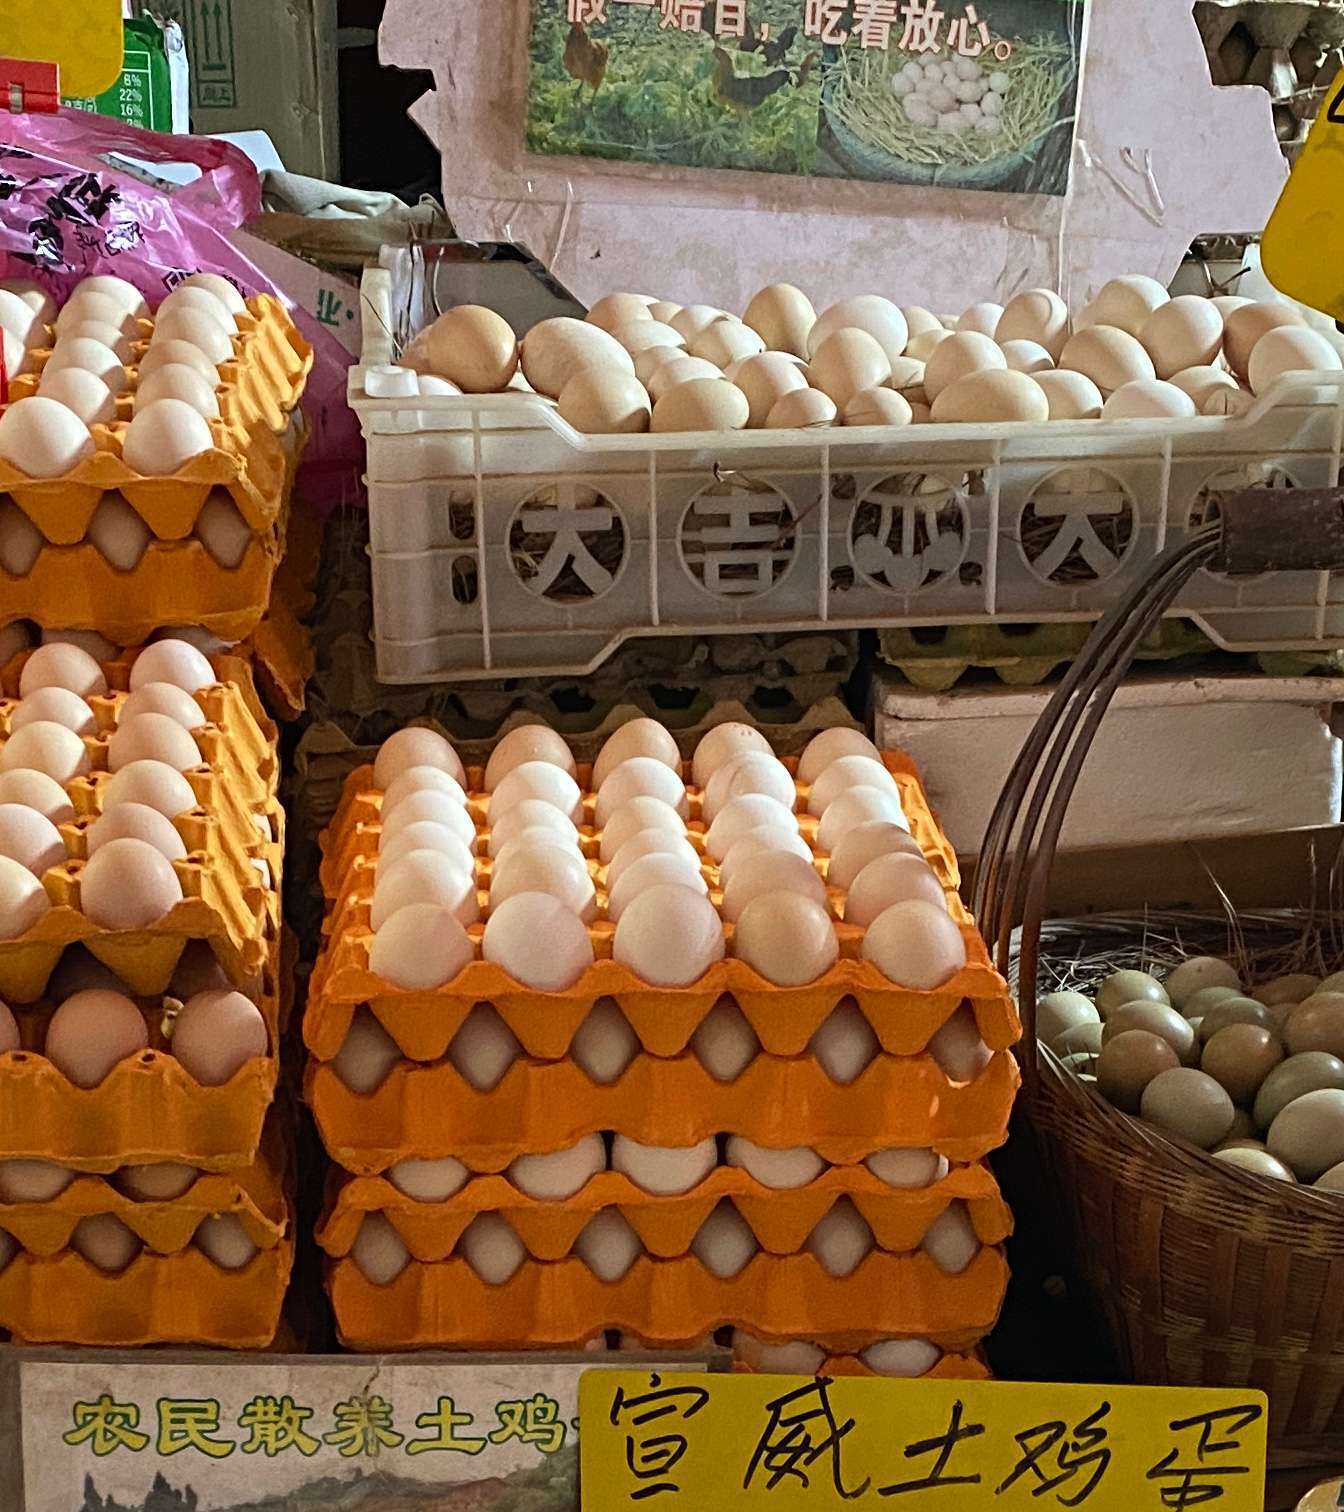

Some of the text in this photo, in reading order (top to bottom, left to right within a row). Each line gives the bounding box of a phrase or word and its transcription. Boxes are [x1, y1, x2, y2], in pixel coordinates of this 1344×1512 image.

[123, 73, 142, 87] 8%
[62, 1392, 579, 1458] 农民散养土鸡
